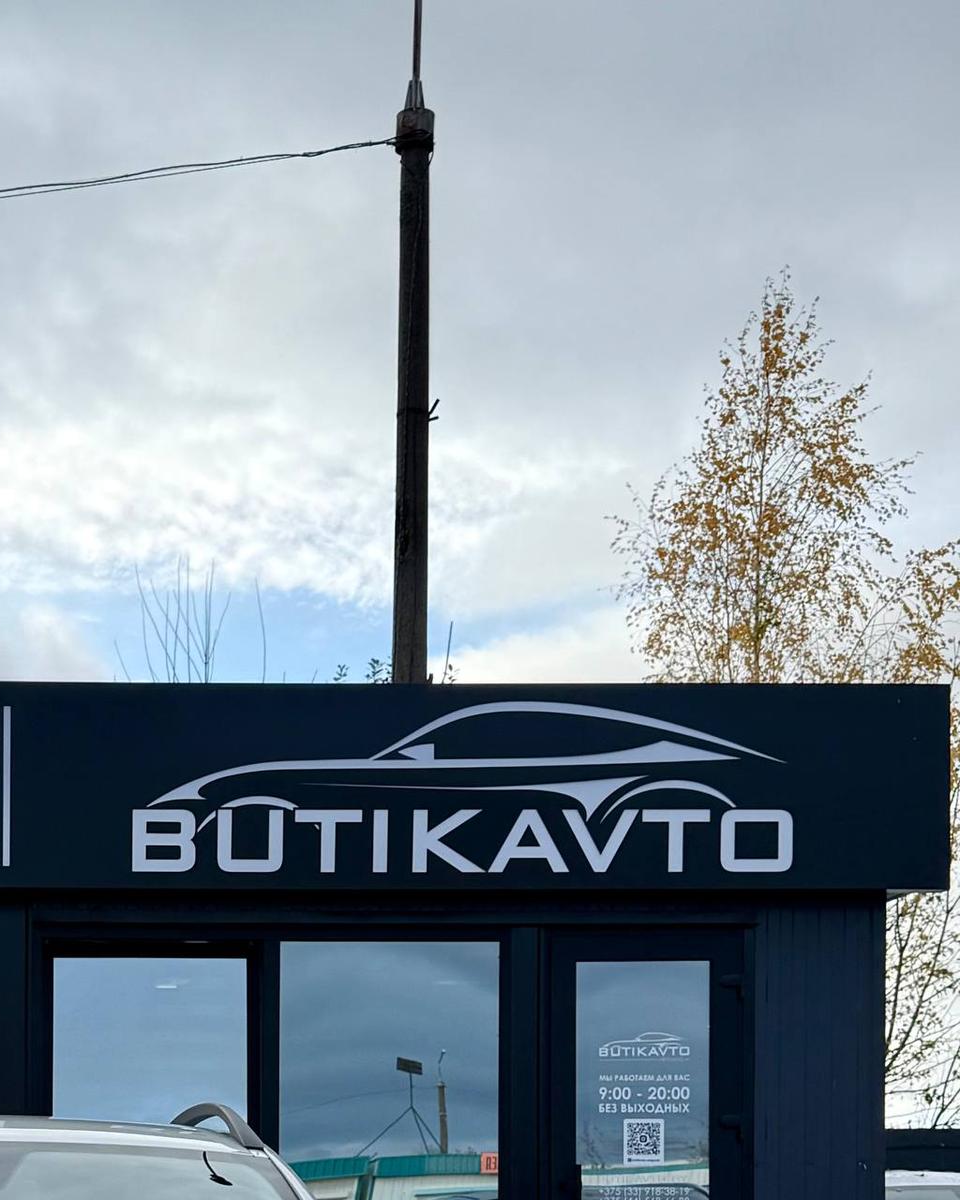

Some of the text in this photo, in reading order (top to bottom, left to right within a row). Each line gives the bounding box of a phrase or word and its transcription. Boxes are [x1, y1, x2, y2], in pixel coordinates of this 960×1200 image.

[131, 807, 794, 875] BUTIKAVTO
[599, 1046, 691, 1057] BUTIKAVTO
[614, 1074, 654, 1082] РАБОТАЕМ
[599, 1086, 632, 1100] 9:00
[647, 1086, 690, 1100] 20:00
[599, 1103, 690, 1114] БЕЗ ВЫХОДНЫХ
[599, 1187, 690, 1197] +375 (33) 918-38-19
